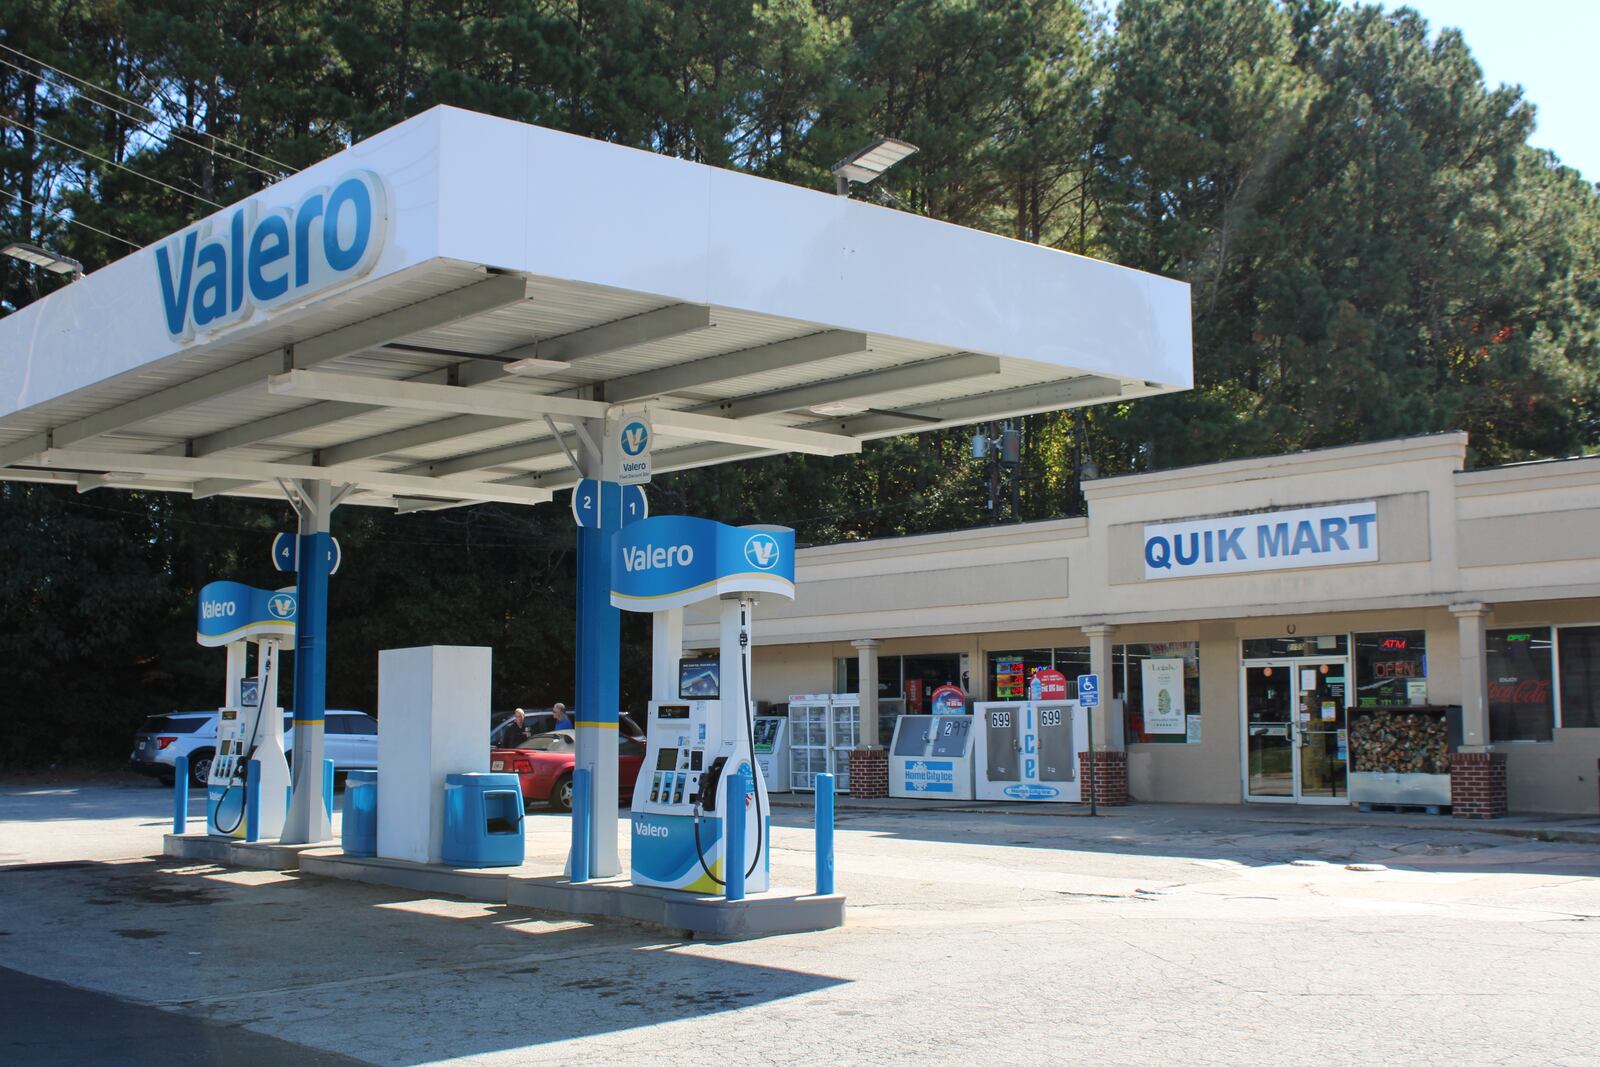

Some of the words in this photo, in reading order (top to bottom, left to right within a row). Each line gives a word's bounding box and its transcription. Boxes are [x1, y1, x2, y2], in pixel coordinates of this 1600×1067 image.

[155, 178, 371, 336] Valero
[623, 462, 646, 472] Valero
[583, 496, 592, 509] 2
[629, 502, 636, 515] 1
[1145, 527, 1247, 570] QUIK
[1257, 514, 1376, 558] MART
[282, 547, 290, 558] 4
[623, 543, 694, 572] Valero
[202, 600, 236, 619] Valero
[1382, 639, 1407, 648] ATM
[1375, 662, 1416, 678] OPEN
[992, 713, 1010, 727] 699
[1042, 711, 1060, 726] 699
[905, 770, 926, 780] Home
[635, 822, 669, 838] Valero
